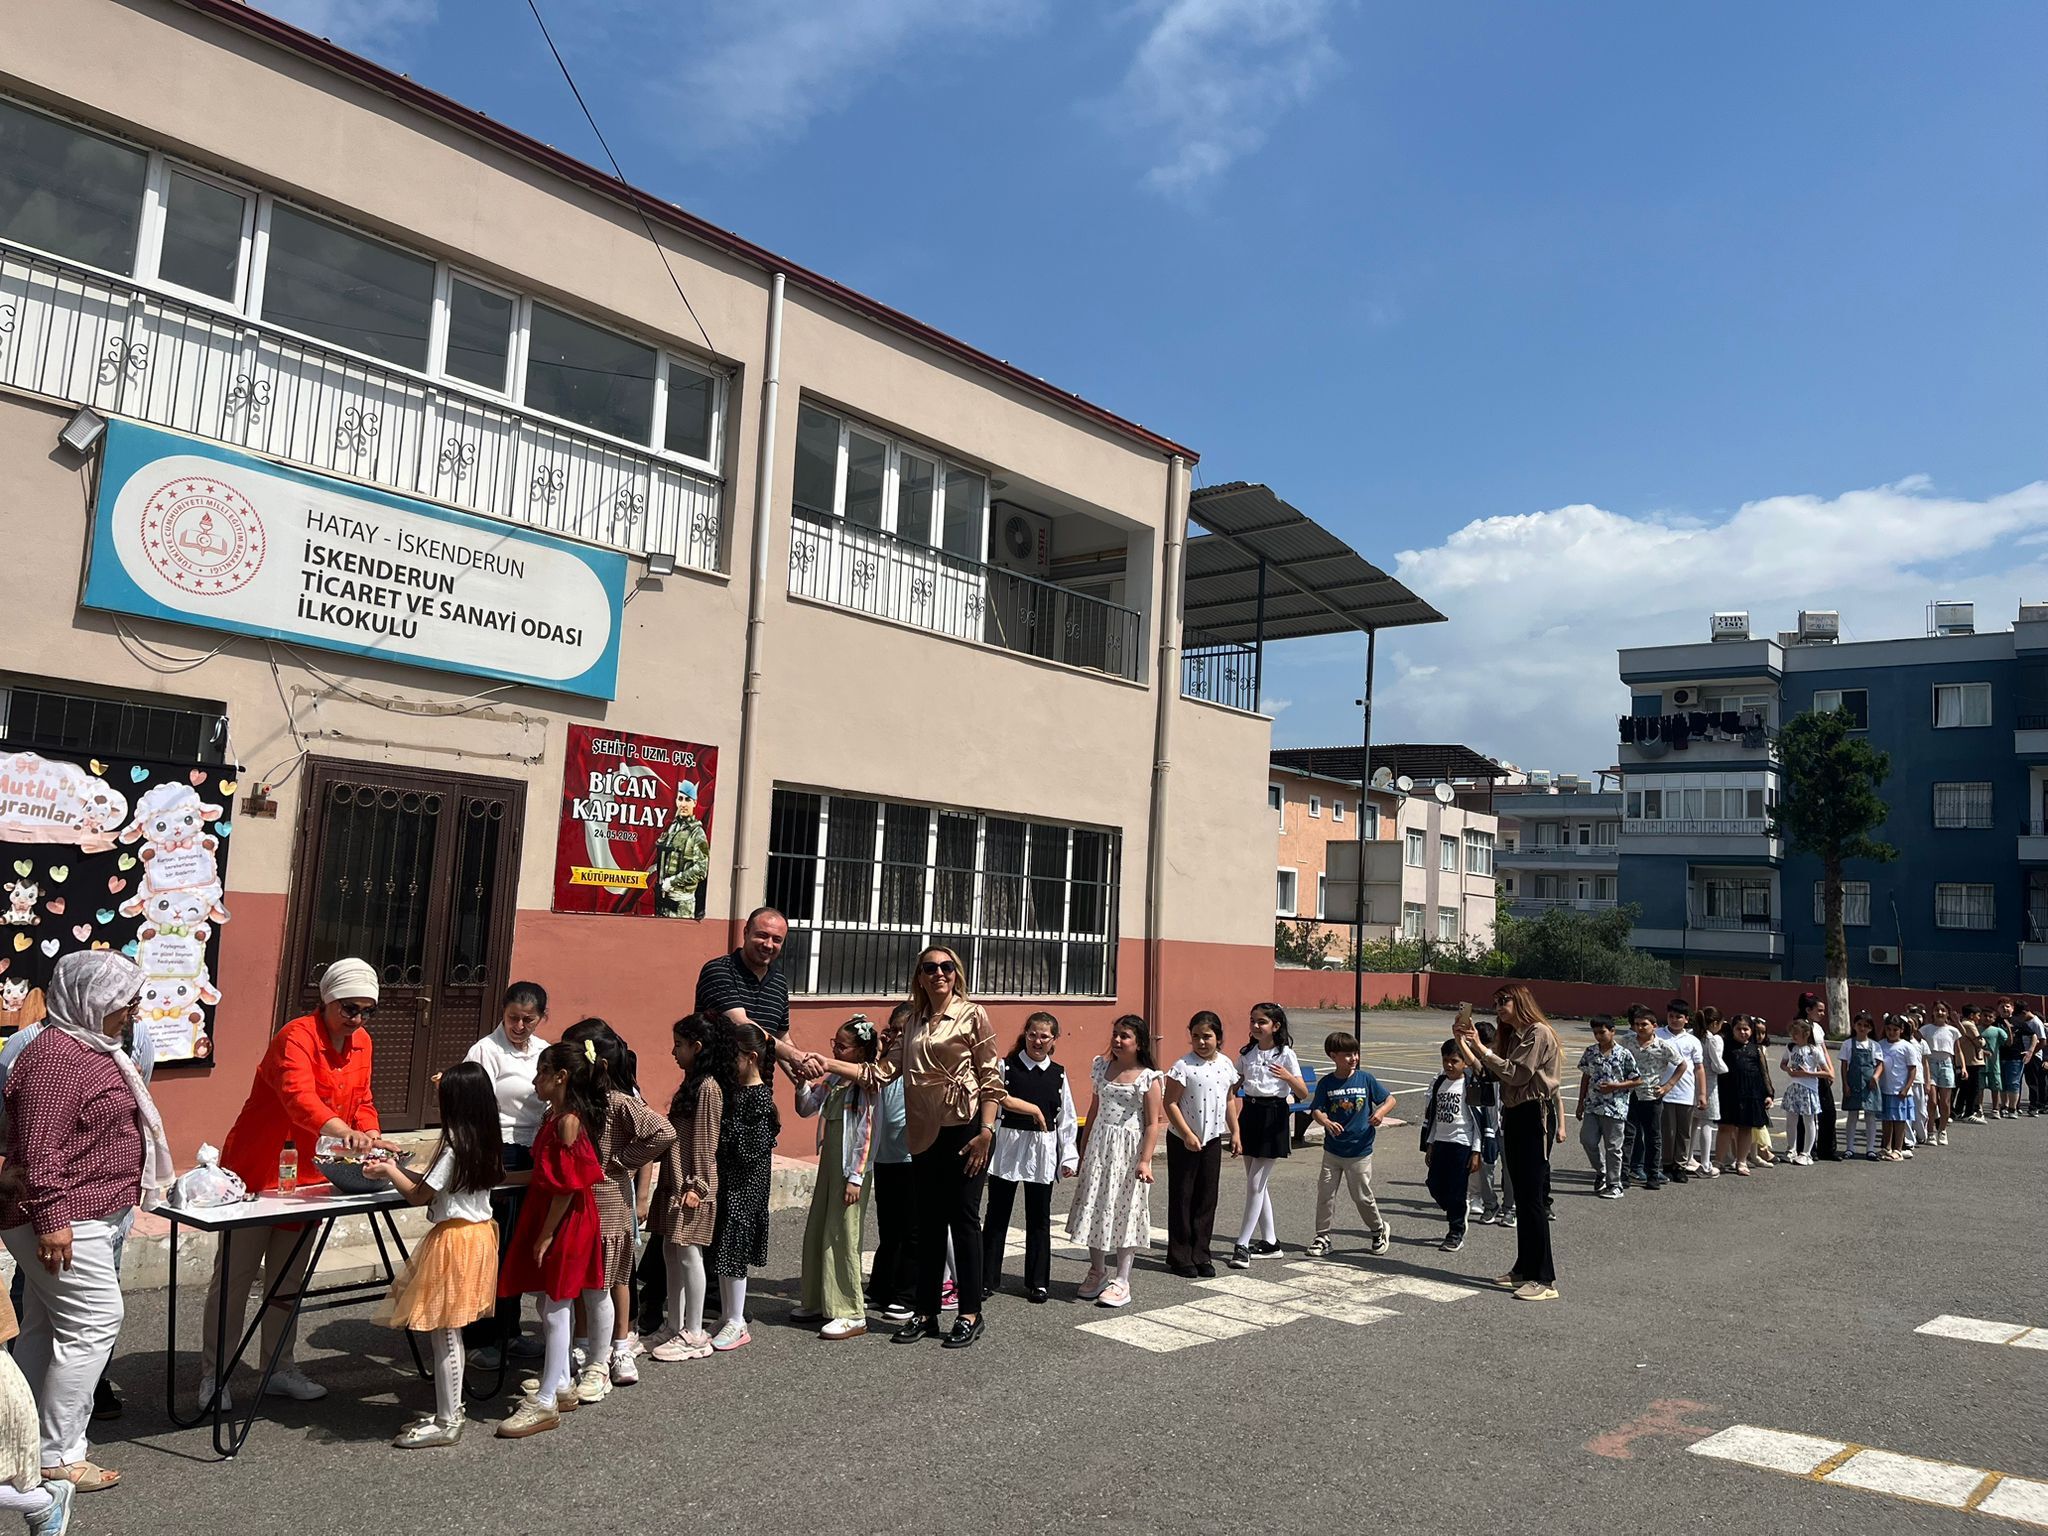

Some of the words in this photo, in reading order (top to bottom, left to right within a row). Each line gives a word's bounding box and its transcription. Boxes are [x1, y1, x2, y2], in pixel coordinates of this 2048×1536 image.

[307, 509, 379, 545] HATAY
[397, 528, 525, 579] İSKENDERUN
[1039, 527, 1047, 567] VESTEL
[303, 538, 455, 595] İSKENDERUN
[297, 593, 418, 640] İLKOKULU
[301, 569, 402, 610] TİCARET
[406, 593, 435, 617] VE
[439, 600, 517, 633] SANAYİ
[521, 618, 583, 647] ODASI
[592, 738, 628, 757] ŞEHİT
[627, 744, 640, 759] P.
[642, 746, 670, 763] UZM.
[672, 751, 697, 767] ÇVŞ.
[589, 768, 657, 800] BİCAN
[572, 797, 669, 828] KAPILAY
[593, 829, 638, 842] 24.05.2022
